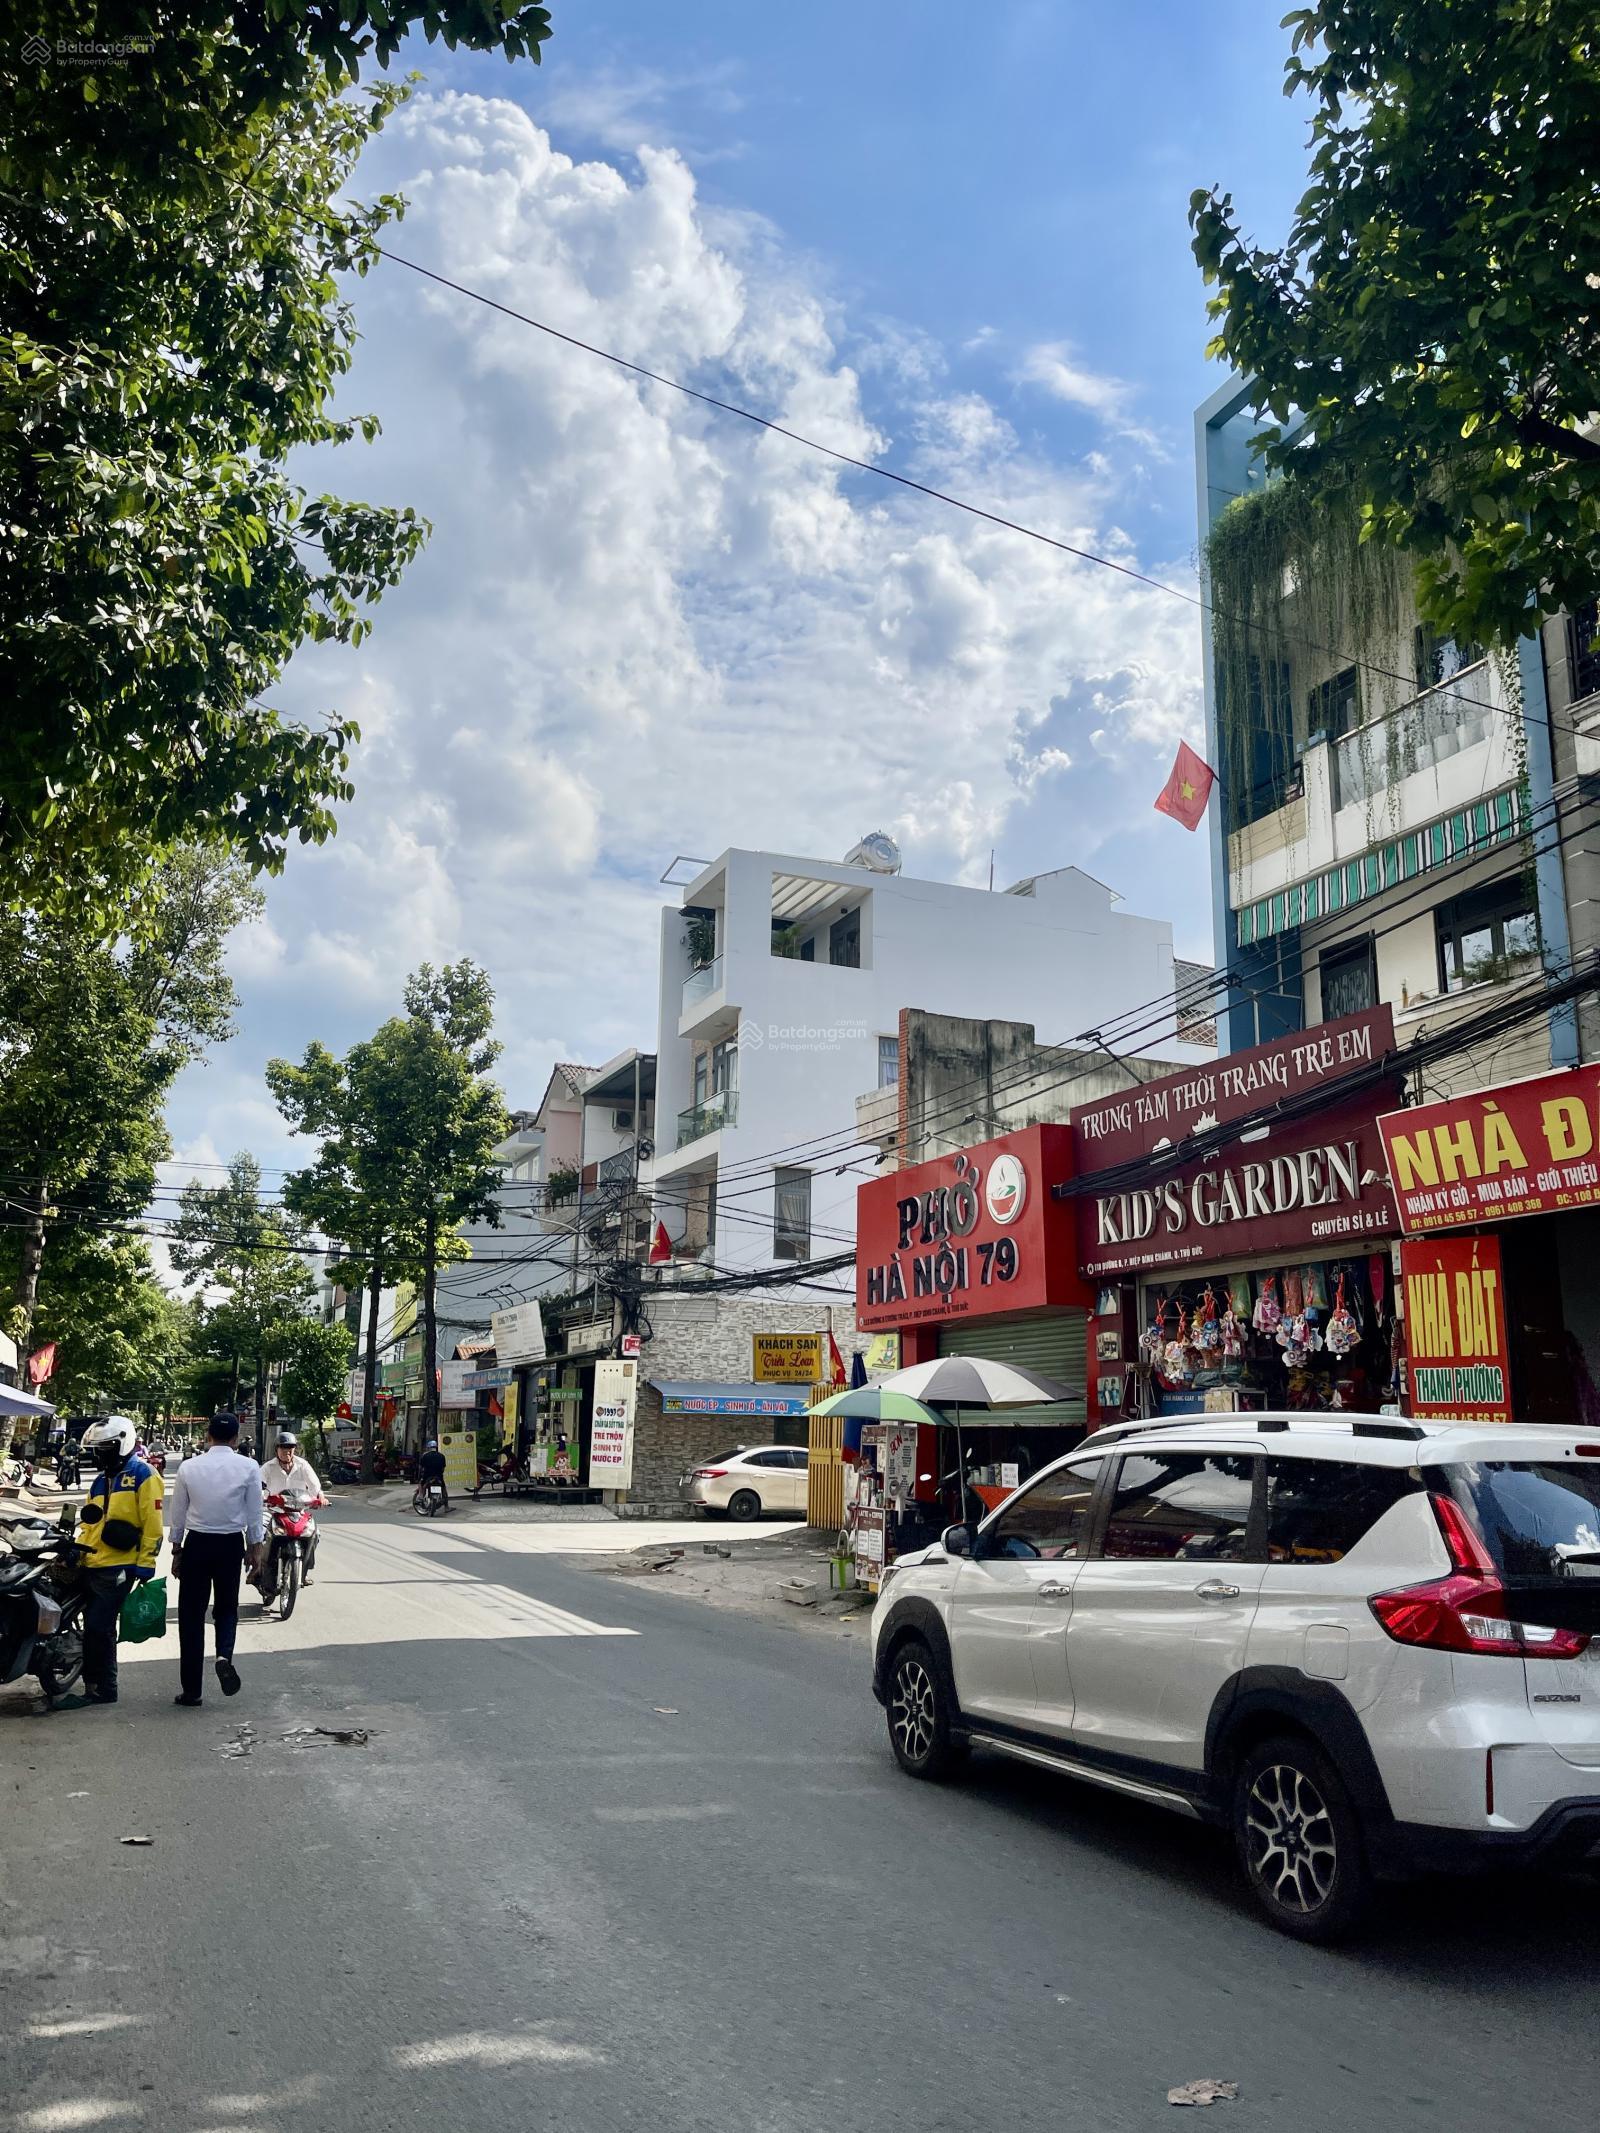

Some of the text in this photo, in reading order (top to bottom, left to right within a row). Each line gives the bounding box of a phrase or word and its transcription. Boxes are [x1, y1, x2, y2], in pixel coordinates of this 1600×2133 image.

[1081, 1024, 1372, 1140] TRUNG TÂM THỜI TRANG TRẺ EM
[1390, 1079, 1600, 1191] NHÀ Đ
[897, 1155, 980, 1250] PHỞ
[1096, 1140, 1362, 1246] KID'S GARDEN
[1406, 1191, 1435, 1217] NHẬN
[1450, 1182, 1470, 1207] GỬI
[1477, 1181, 1502, 1202] MUA
[1504, 1174, 1528, 1199] BÁN
[1537, 1166, 1560, 1192] GIỚI
[1563, 1161, 1598, 1189] THIỆU
[1411, 1218, 1423, 1230] ĐT:
[1444, 1211, 1455, 1223] 45
[1455, 1210, 1467, 1222] 56
[1467, 1207, 1478, 1220] 57
[1484, 1204, 1505, 1217] 0961
[1556, 1194, 1573, 1206] ĐC:
[1311, 1215, 1351, 1238] CHUYÊN
[1365, 1212, 1375, 1228] &
[1376, 1205, 1389, 1226] LẺ
[867, 1236, 1019, 1306] HÀ NỘI 79
[1408, 1240, 1499, 1358] NHÀ ĐẤT
[758, 1336, 818, 1352] KHÁCH SẠN
[724, 1400, 744, 1411] SINH
[1414, 1362, 1505, 1404] THANH PHƯƠNG
[593, 1443, 611, 1452] SINH
[1534, 1694, 1581, 1703] SUZUKI
